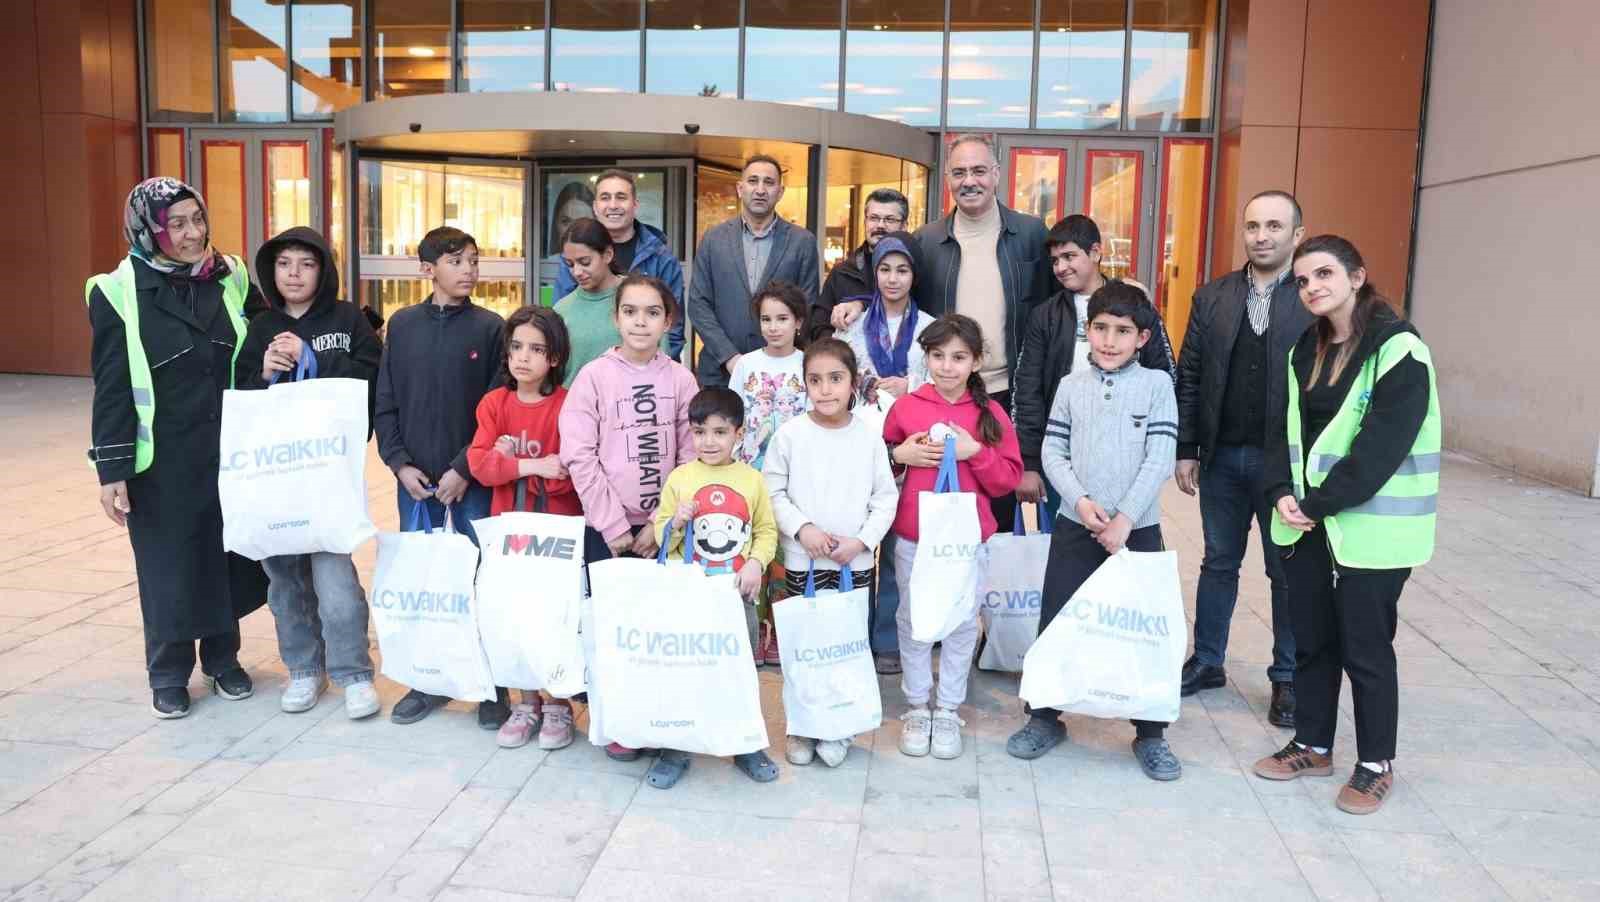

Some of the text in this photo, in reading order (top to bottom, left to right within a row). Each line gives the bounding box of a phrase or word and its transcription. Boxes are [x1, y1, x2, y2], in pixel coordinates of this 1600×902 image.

[632, 384, 657, 426] NOT
[637, 431, 661, 488] WHAT
[640, 492, 661, 510] IS
[931, 544, 952, 558] LC
[615, 625, 641, 651] LC
[794, 648, 816, 662] LC
